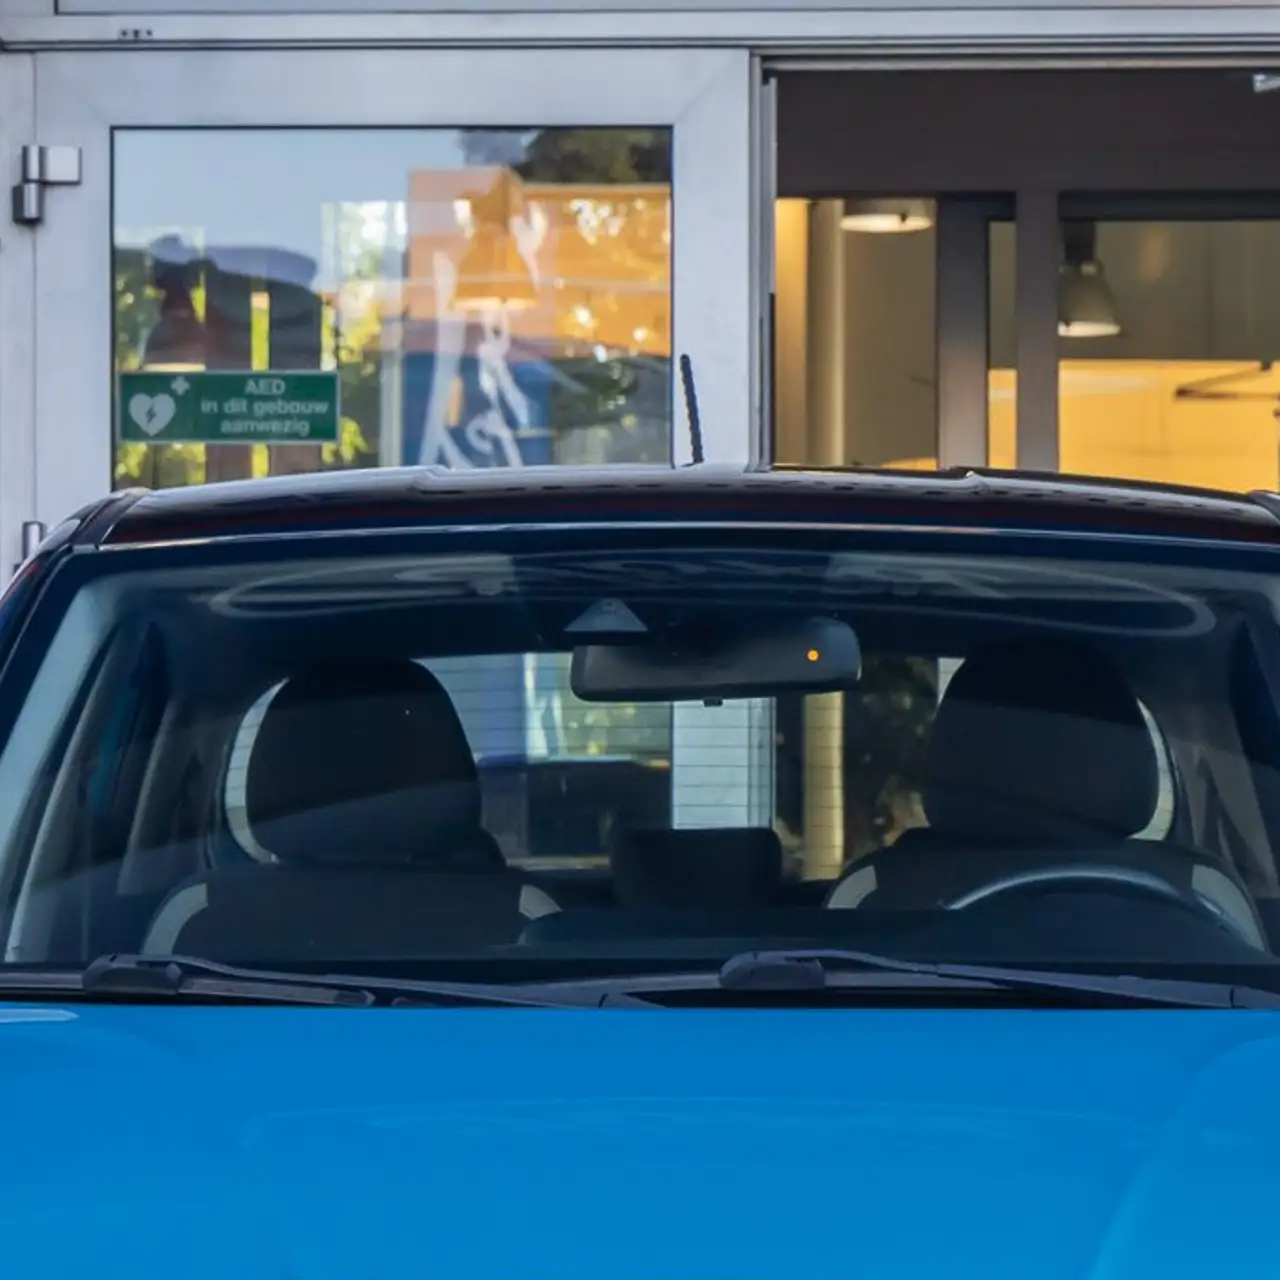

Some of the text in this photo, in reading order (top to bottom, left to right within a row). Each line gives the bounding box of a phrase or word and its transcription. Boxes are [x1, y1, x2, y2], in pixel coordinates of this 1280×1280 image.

[244, 378, 286, 395] AED
[200, 397, 330, 418] in dit gebouw
[220, 418, 310, 437] aanwezig
